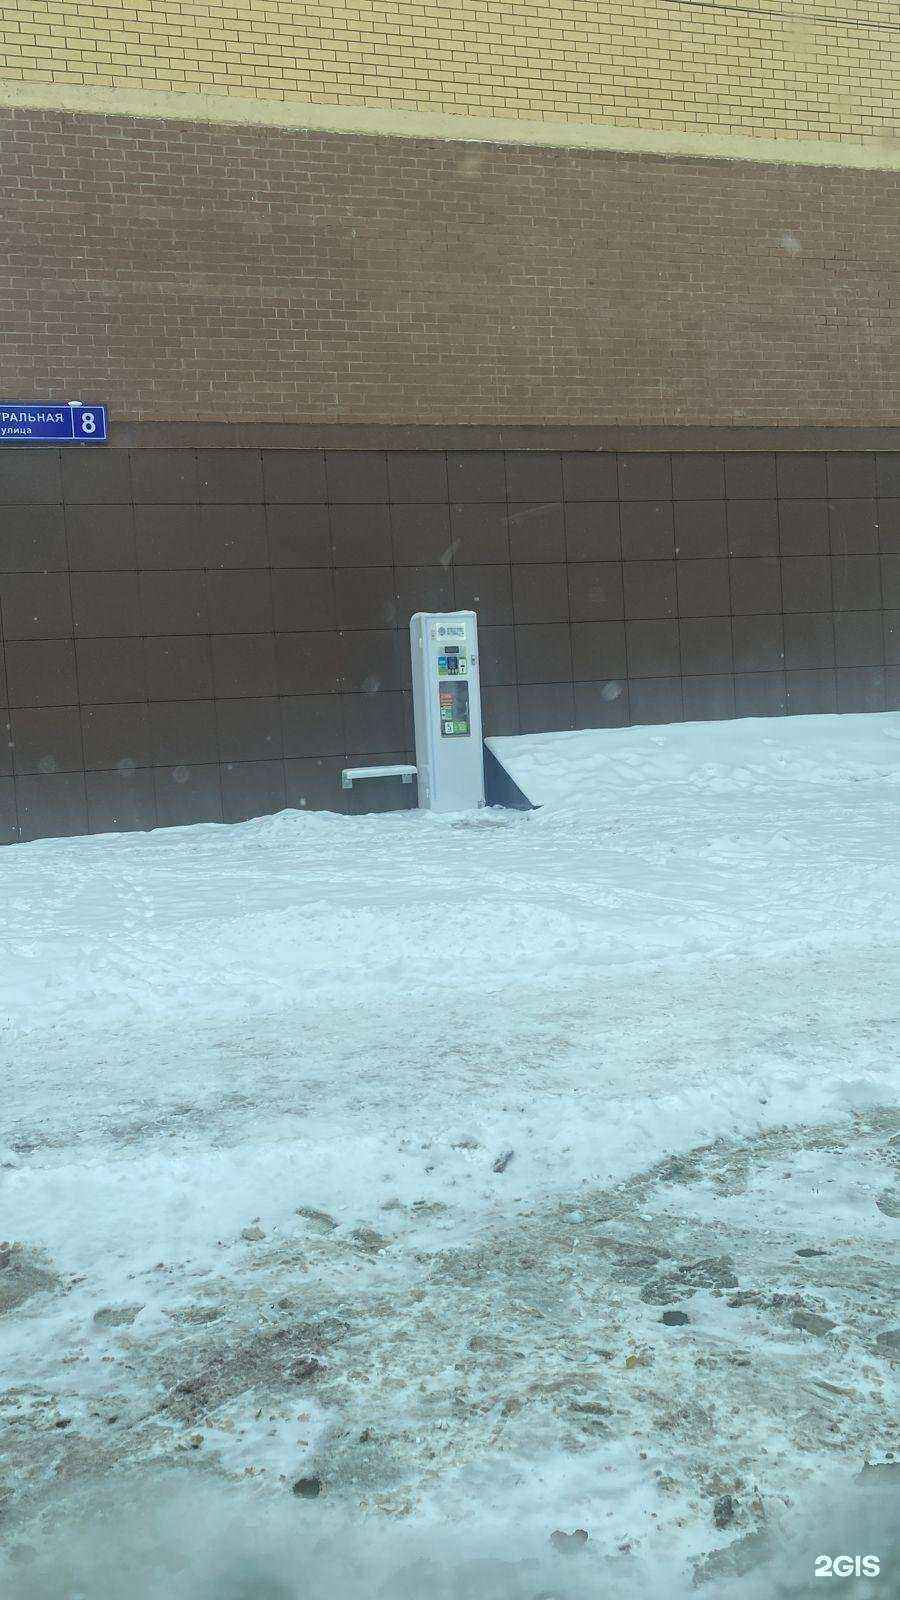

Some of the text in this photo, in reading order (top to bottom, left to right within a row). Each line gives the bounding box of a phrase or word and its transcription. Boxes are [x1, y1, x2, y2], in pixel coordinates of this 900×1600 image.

[0, 412, 64, 423] РАЛЬНАЯ
[81, 412, 96, 434] 8
[1, 426, 32, 436] улица
